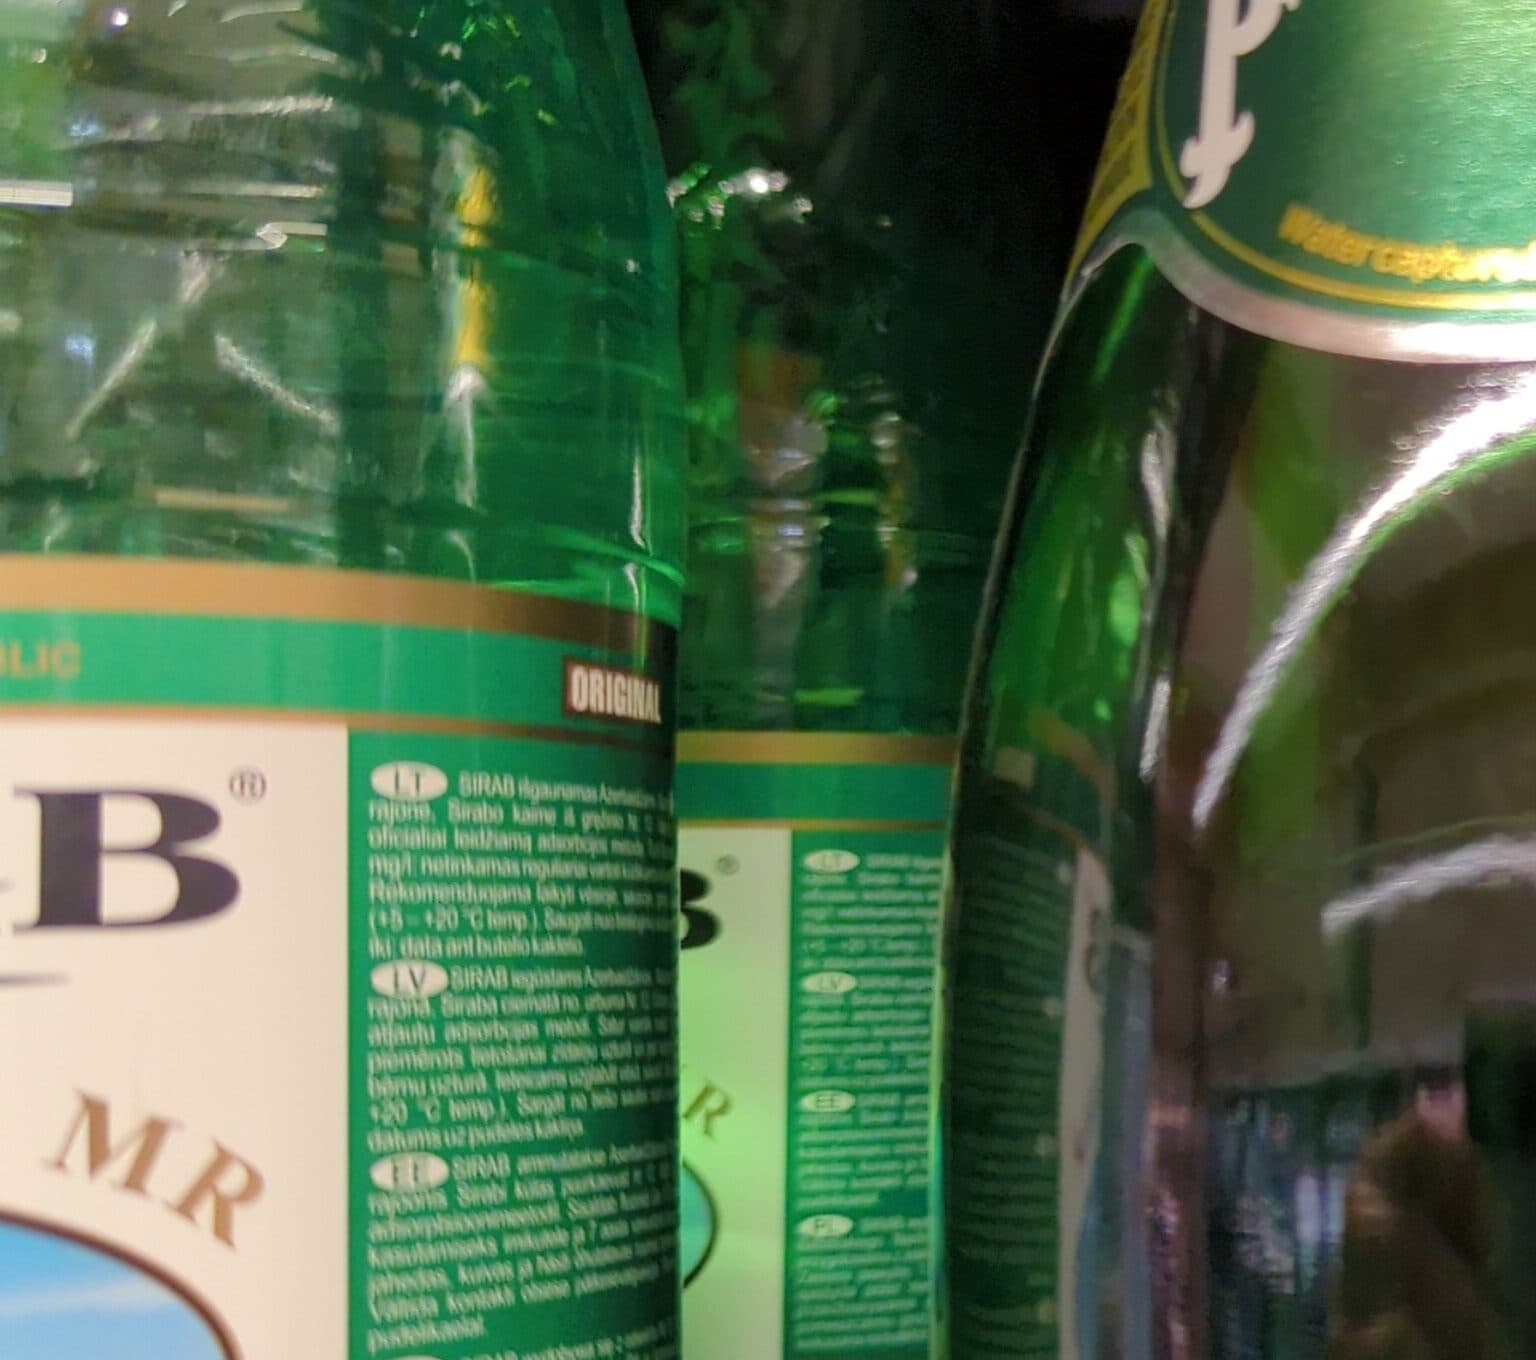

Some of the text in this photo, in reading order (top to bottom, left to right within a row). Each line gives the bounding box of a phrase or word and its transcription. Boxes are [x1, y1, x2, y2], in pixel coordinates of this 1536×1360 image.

[570, 664, 662, 725] ORIGINAL
[0, 784, 241, 936] B
[683, 1080, 732, 1140] R
[43, 1087, 265, 1250] MR
